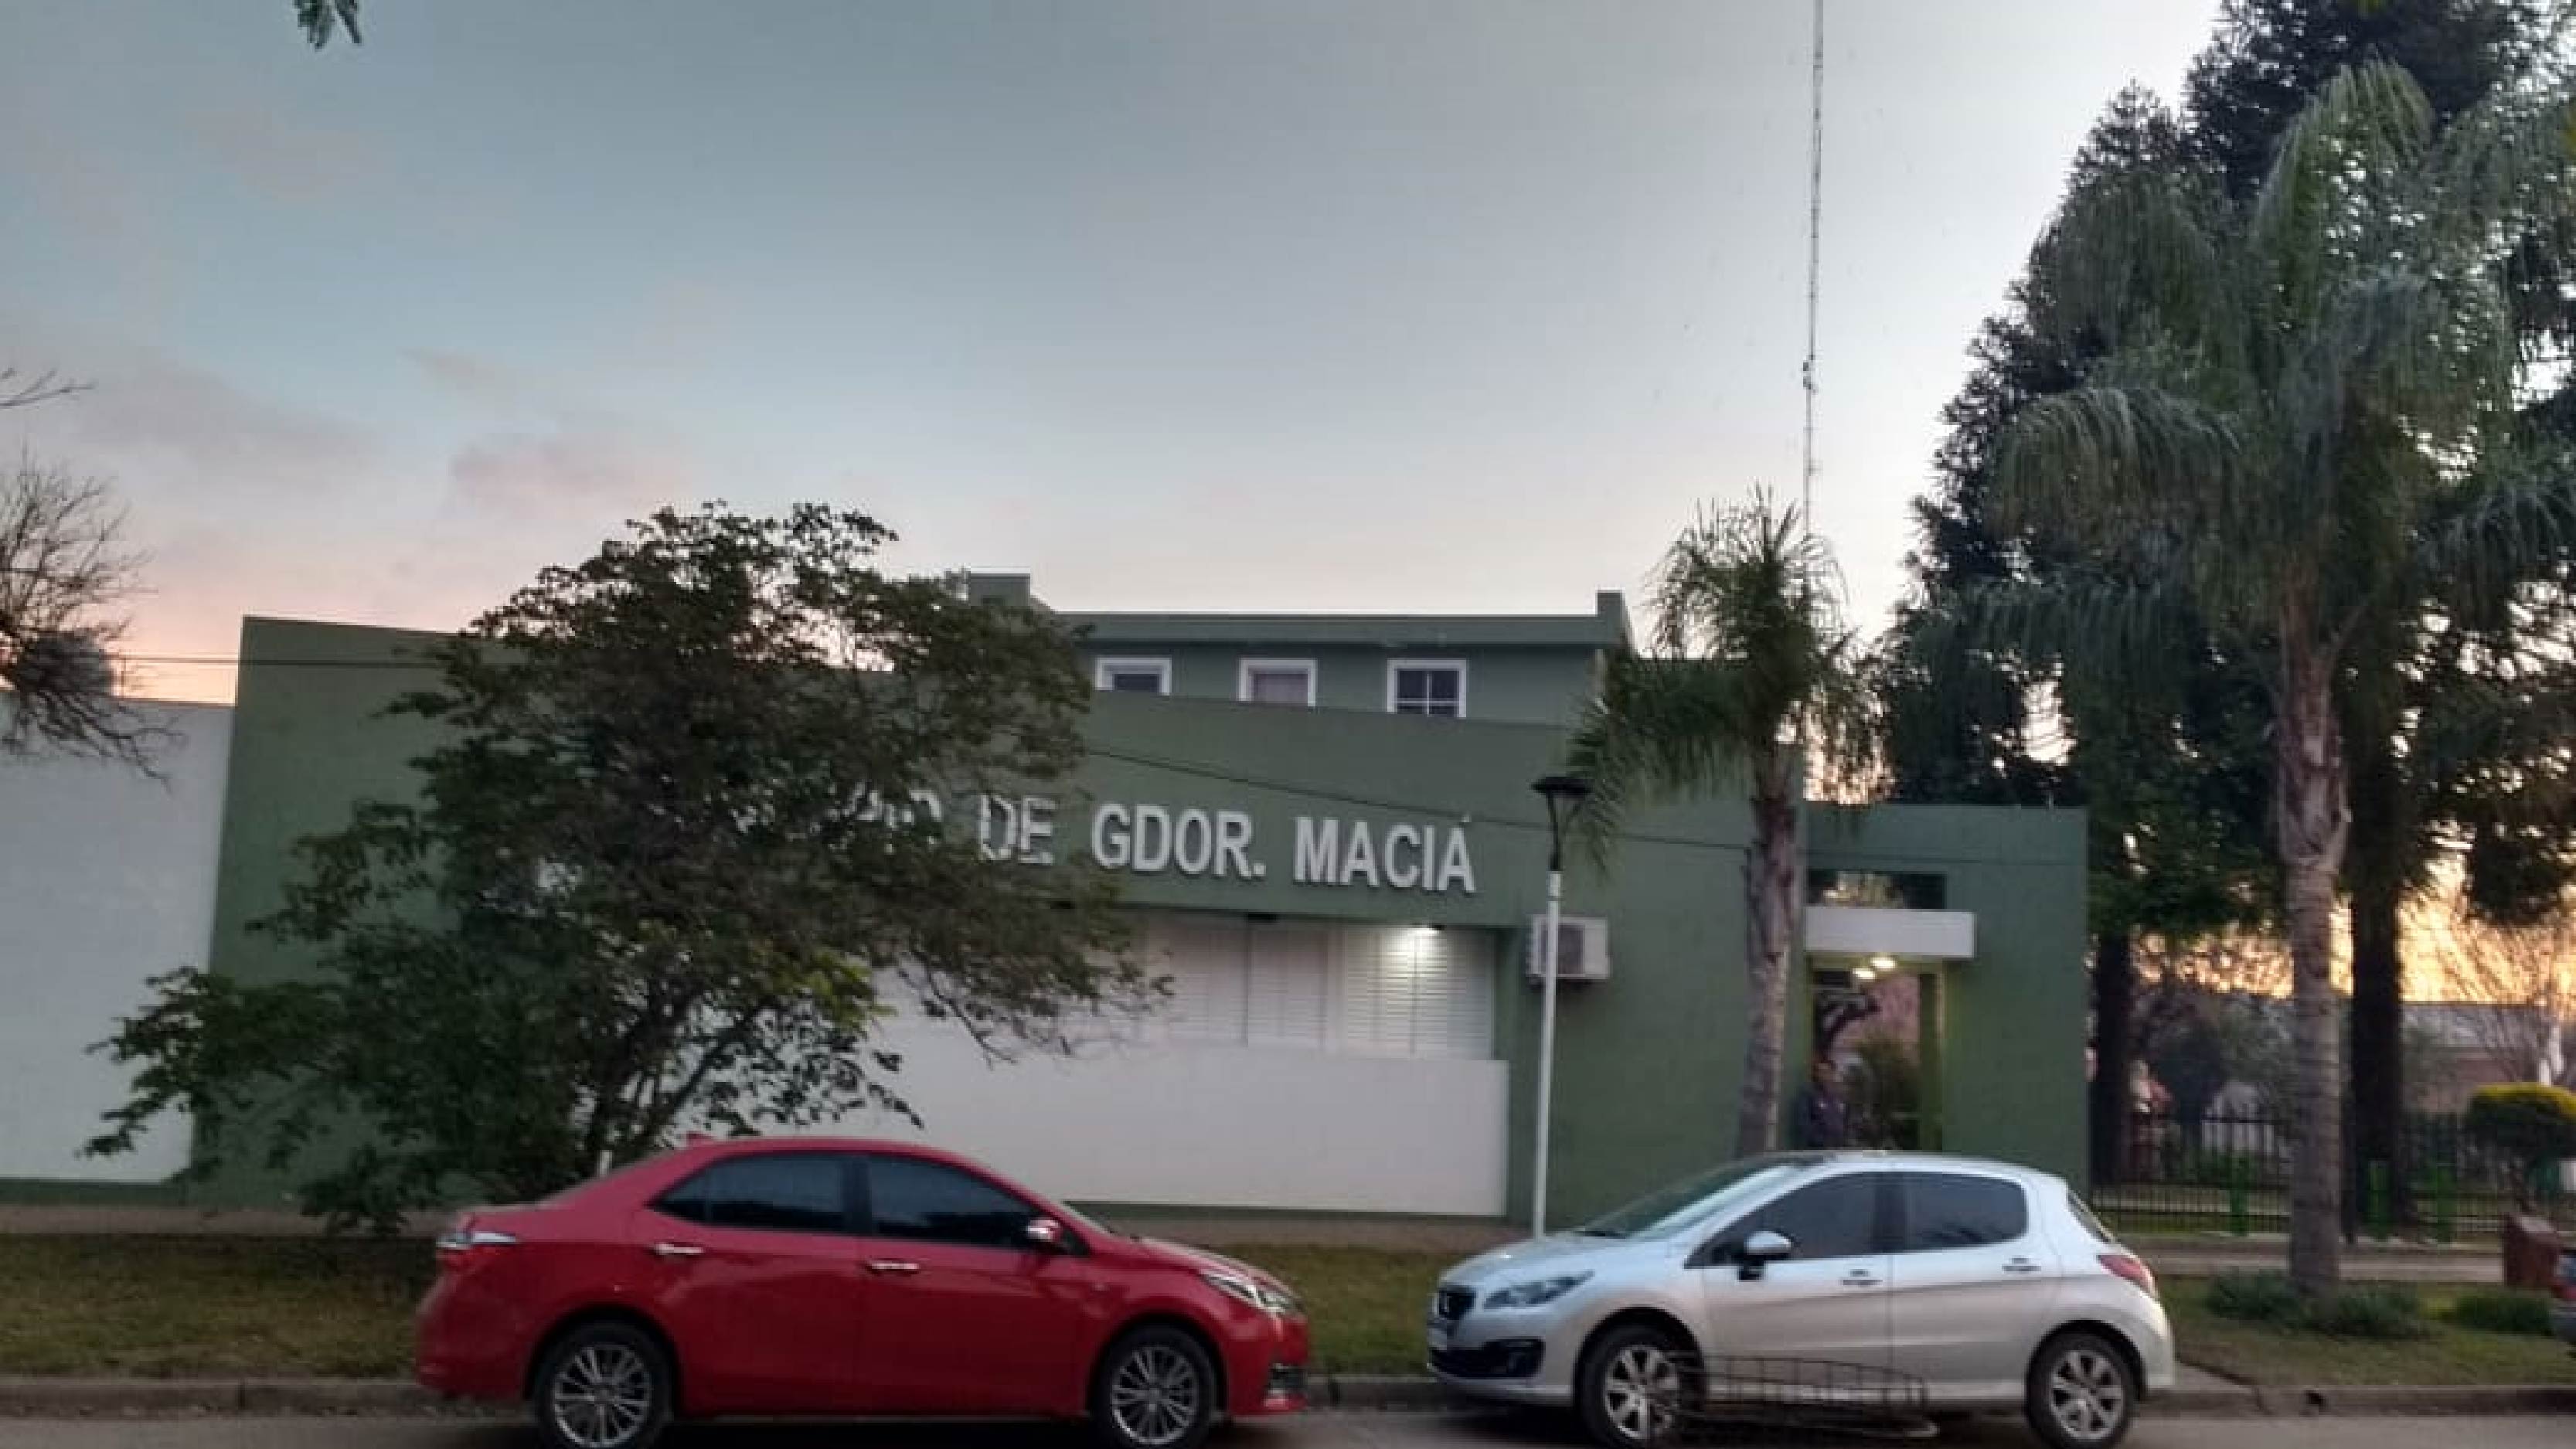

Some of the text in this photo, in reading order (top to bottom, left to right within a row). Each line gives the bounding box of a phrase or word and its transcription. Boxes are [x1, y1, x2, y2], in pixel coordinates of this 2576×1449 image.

[978, 794, 1056, 864] DE
[1091, 802, 1266, 879] GDOR.
[1294, 812, 1475, 893] MACIÁ
